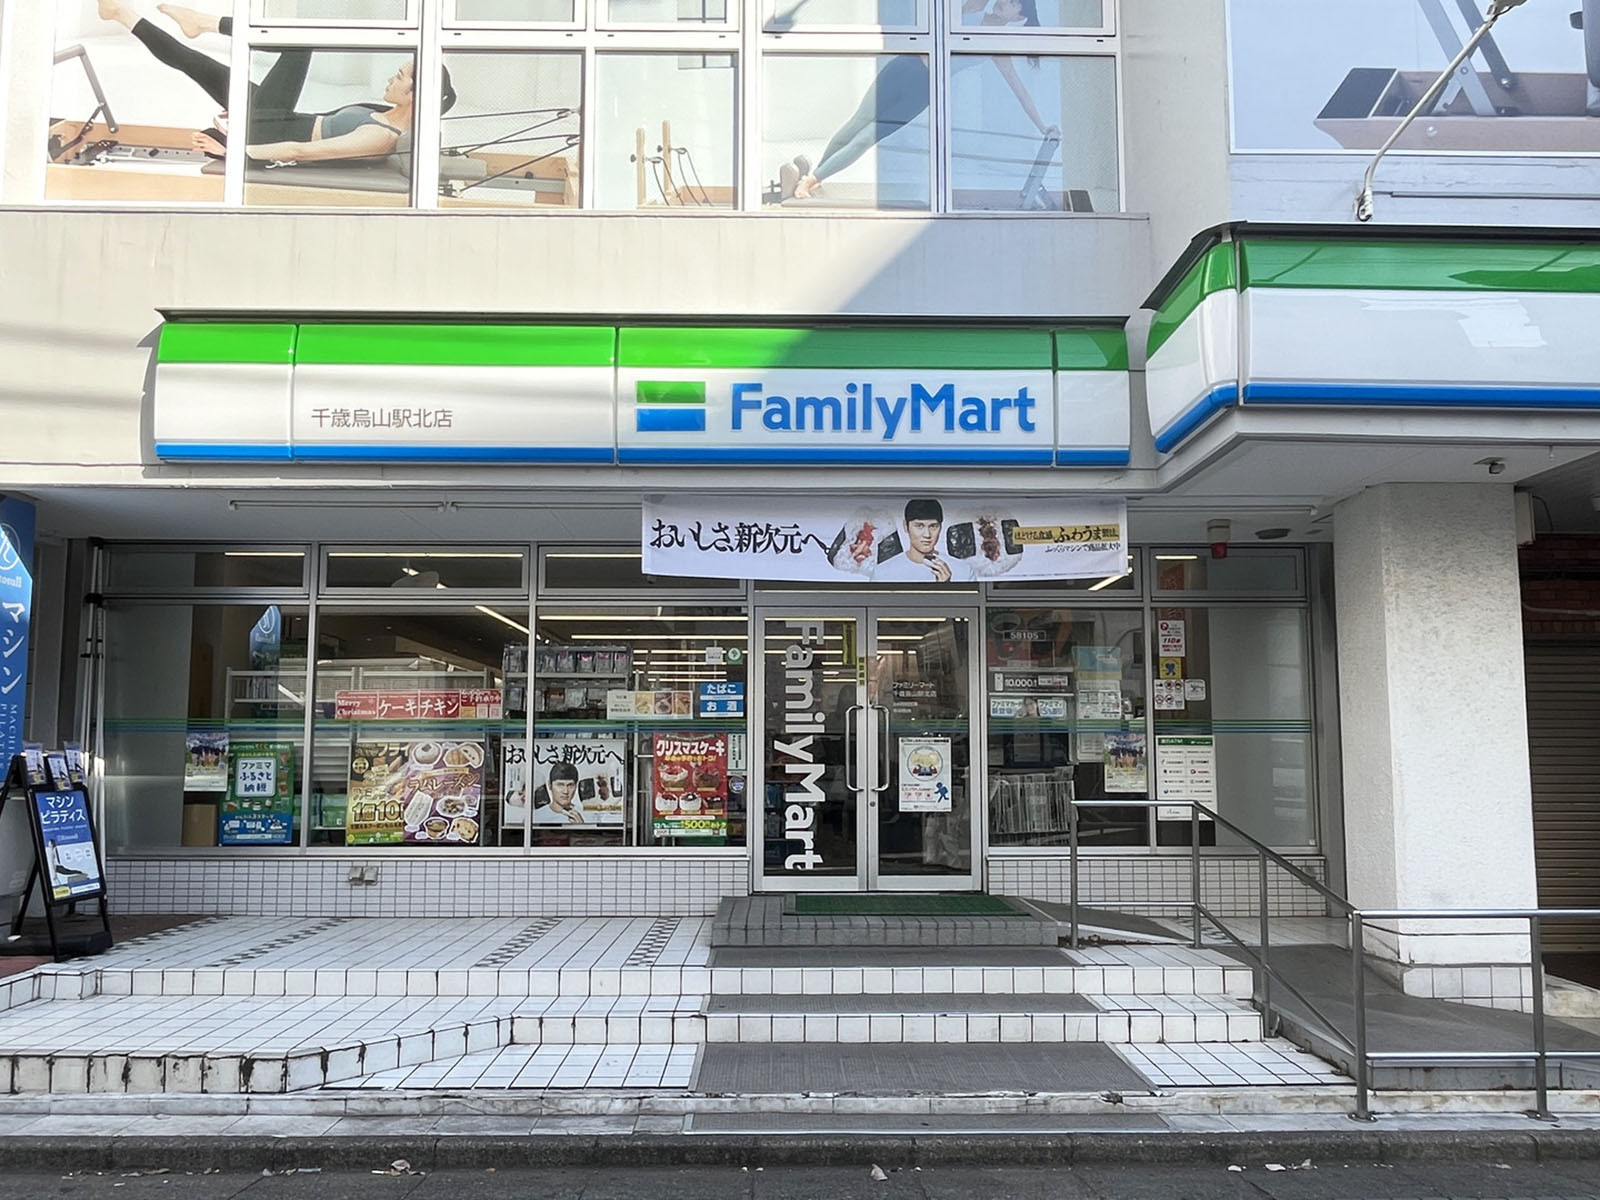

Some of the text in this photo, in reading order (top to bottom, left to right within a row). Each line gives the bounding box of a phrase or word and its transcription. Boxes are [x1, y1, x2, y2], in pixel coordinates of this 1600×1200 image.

[312, 408, 453, 429] 千歳烏山駅北店
[731, 382, 1036, 441] FamilyMart
[2, 602, 25, 694] マシン
[707, 683, 736, 694] たばこ
[380, 699, 417, 716] ケーキ
[420, 698, 459, 716] チキン
[656, 740, 725, 756] クリスマスケーキ
[774, 620, 826, 870] FamilyMart
[240, 771, 273, 781] ふるさと
[407, 774, 479, 792] ラムレーズン
[244, 783, 267, 792] 納税
[46, 795, 74, 808] マシン
[41, 809, 86, 824] ピラティス
[352, 801, 404, 822] 1個10
